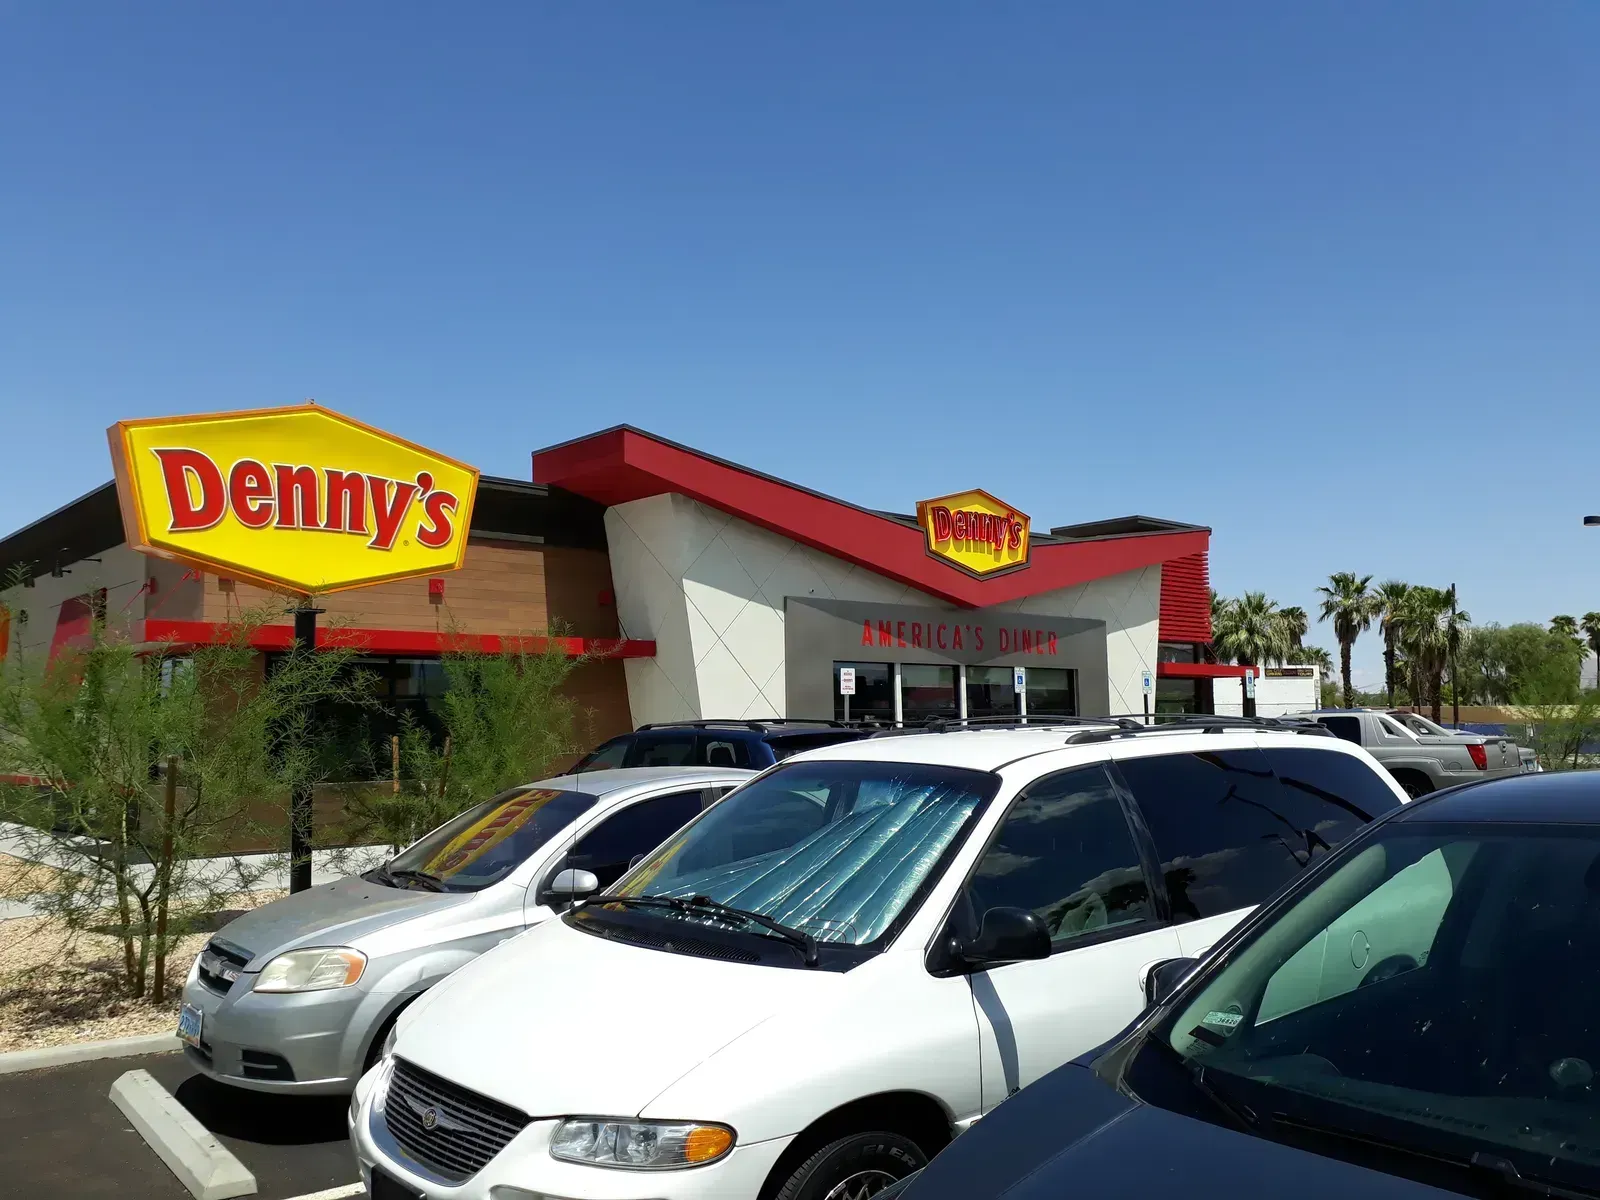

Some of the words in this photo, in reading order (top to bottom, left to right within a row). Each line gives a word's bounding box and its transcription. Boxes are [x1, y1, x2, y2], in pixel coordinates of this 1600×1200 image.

[149, 446, 460, 551] Denny's
[931, 505, 1022, 550] Denny's
[861, 619, 985, 651] AMERICA'S
[1000, 627, 1059, 655] DINER
